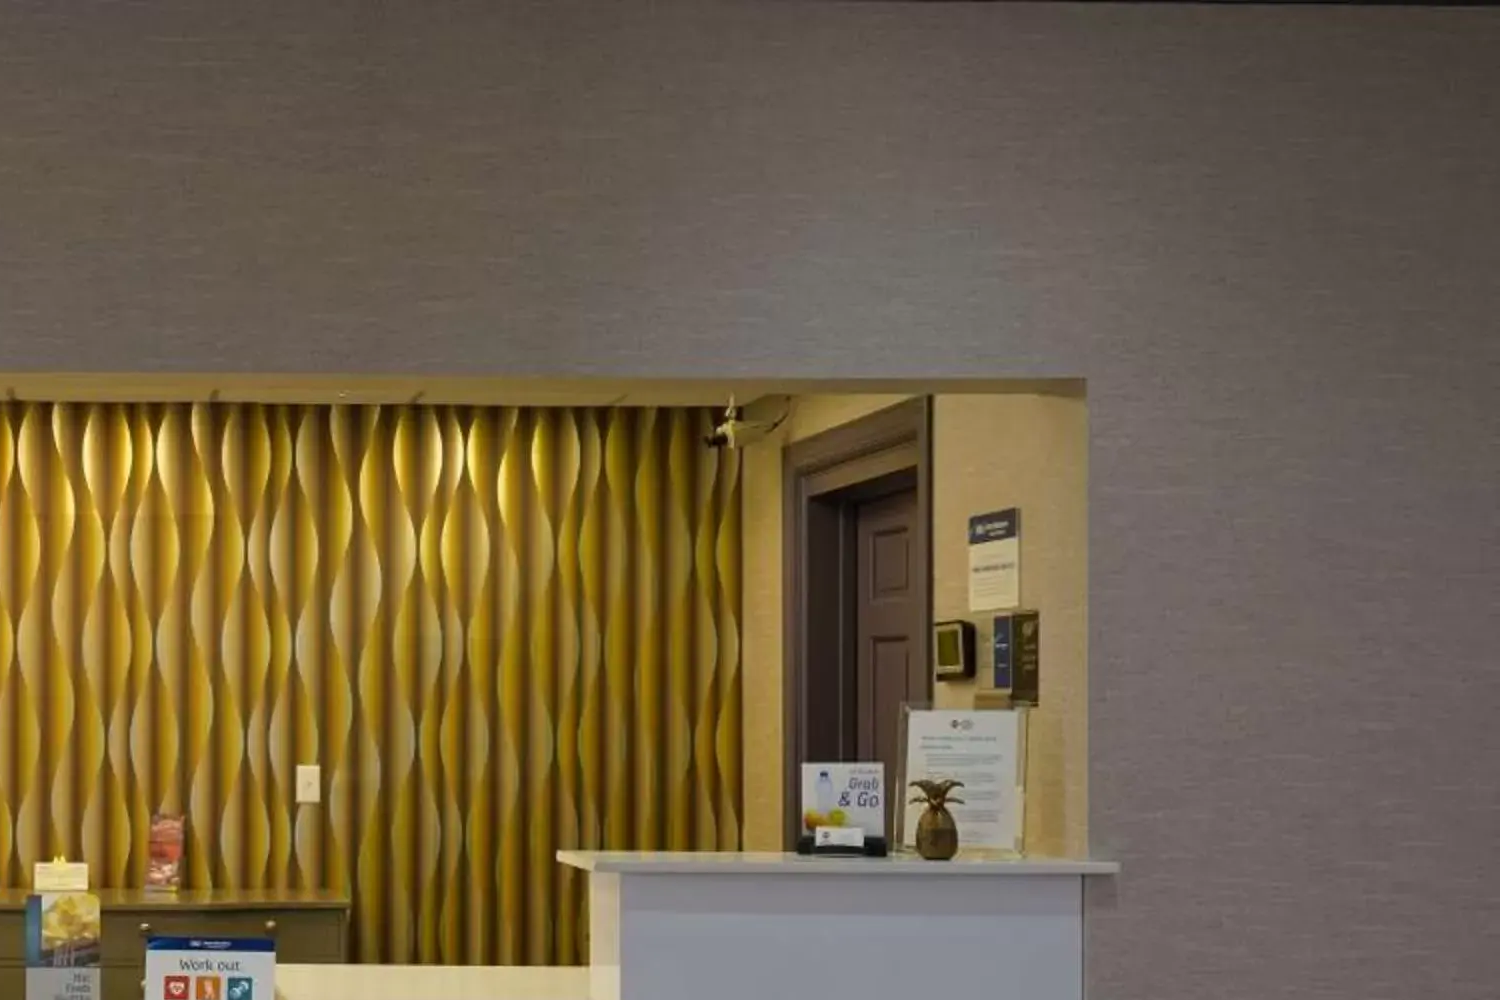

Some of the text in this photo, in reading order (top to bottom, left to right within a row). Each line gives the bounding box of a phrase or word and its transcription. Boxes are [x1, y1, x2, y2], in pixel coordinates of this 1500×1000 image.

[848, 777, 879, 790] Grab
[838, 791, 879, 807] & Go
[180, 960, 212, 971] Work
